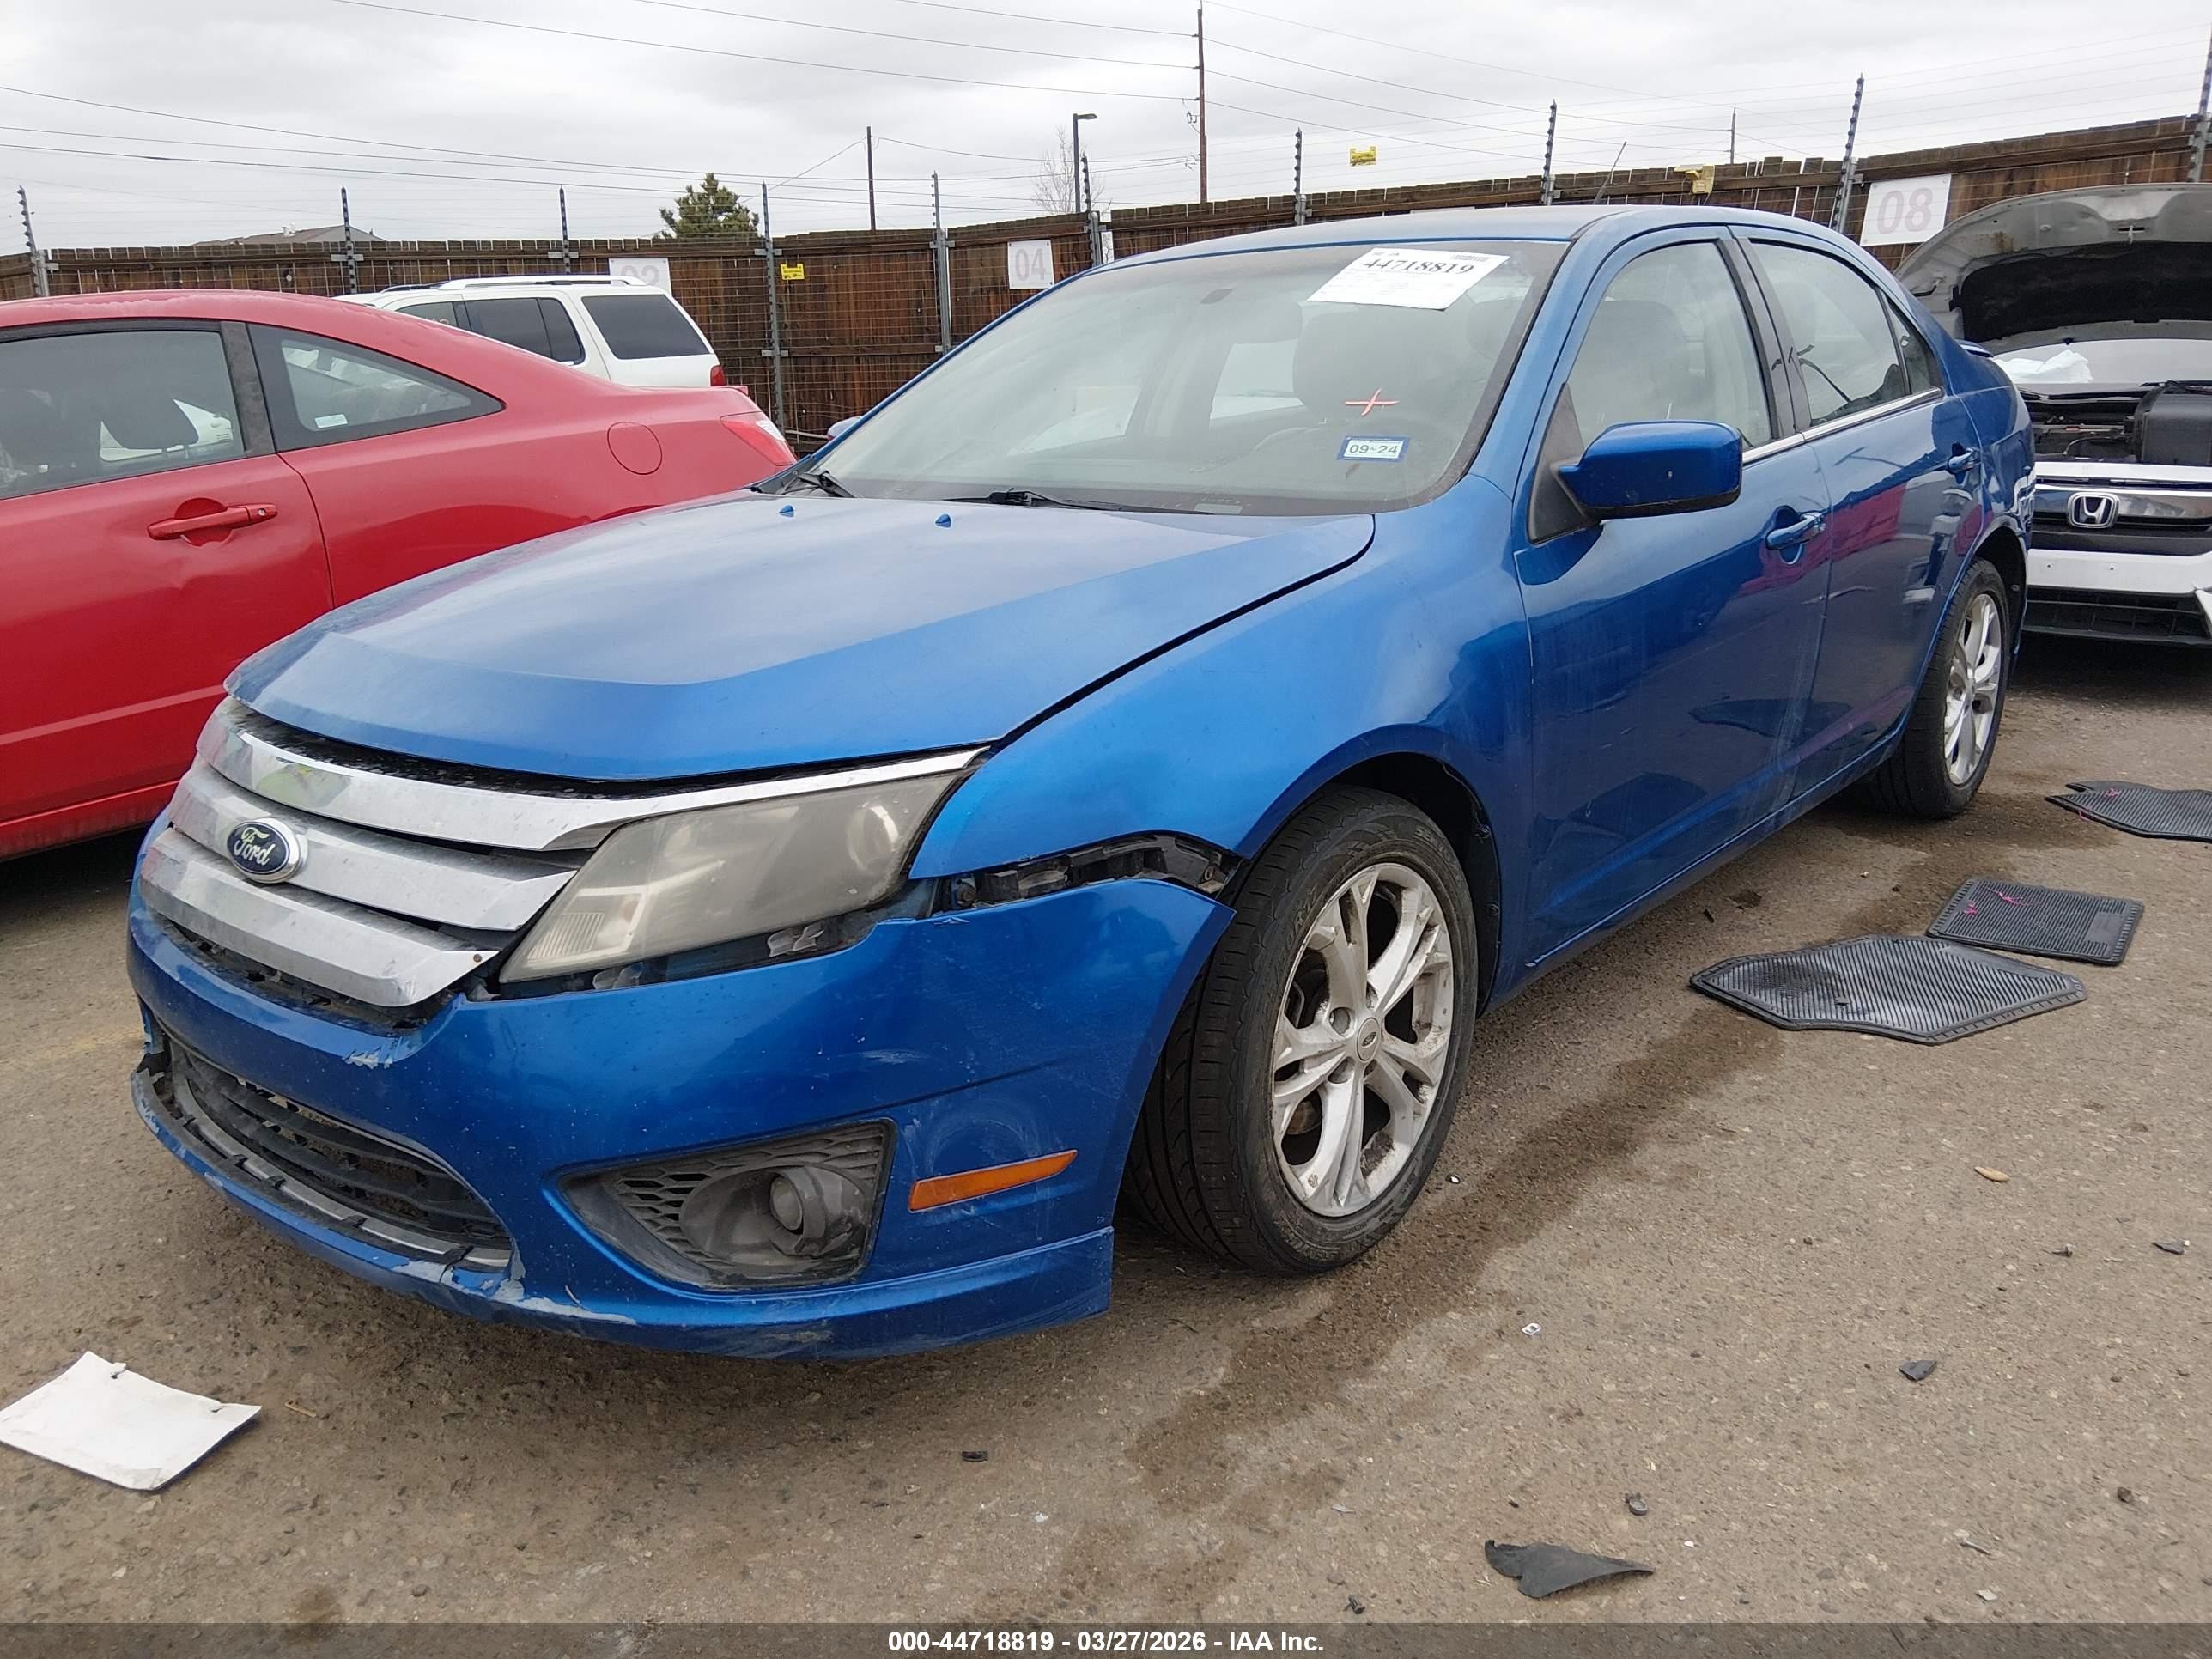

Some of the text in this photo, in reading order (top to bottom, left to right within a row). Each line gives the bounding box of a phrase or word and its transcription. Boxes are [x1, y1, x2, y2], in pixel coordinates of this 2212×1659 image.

[1877, 188, 1933, 234] 08
[1015, 249, 1045, 281] 04
[1364, 258, 1474, 274] 44718819
[234, 827, 275, 866] Ford
